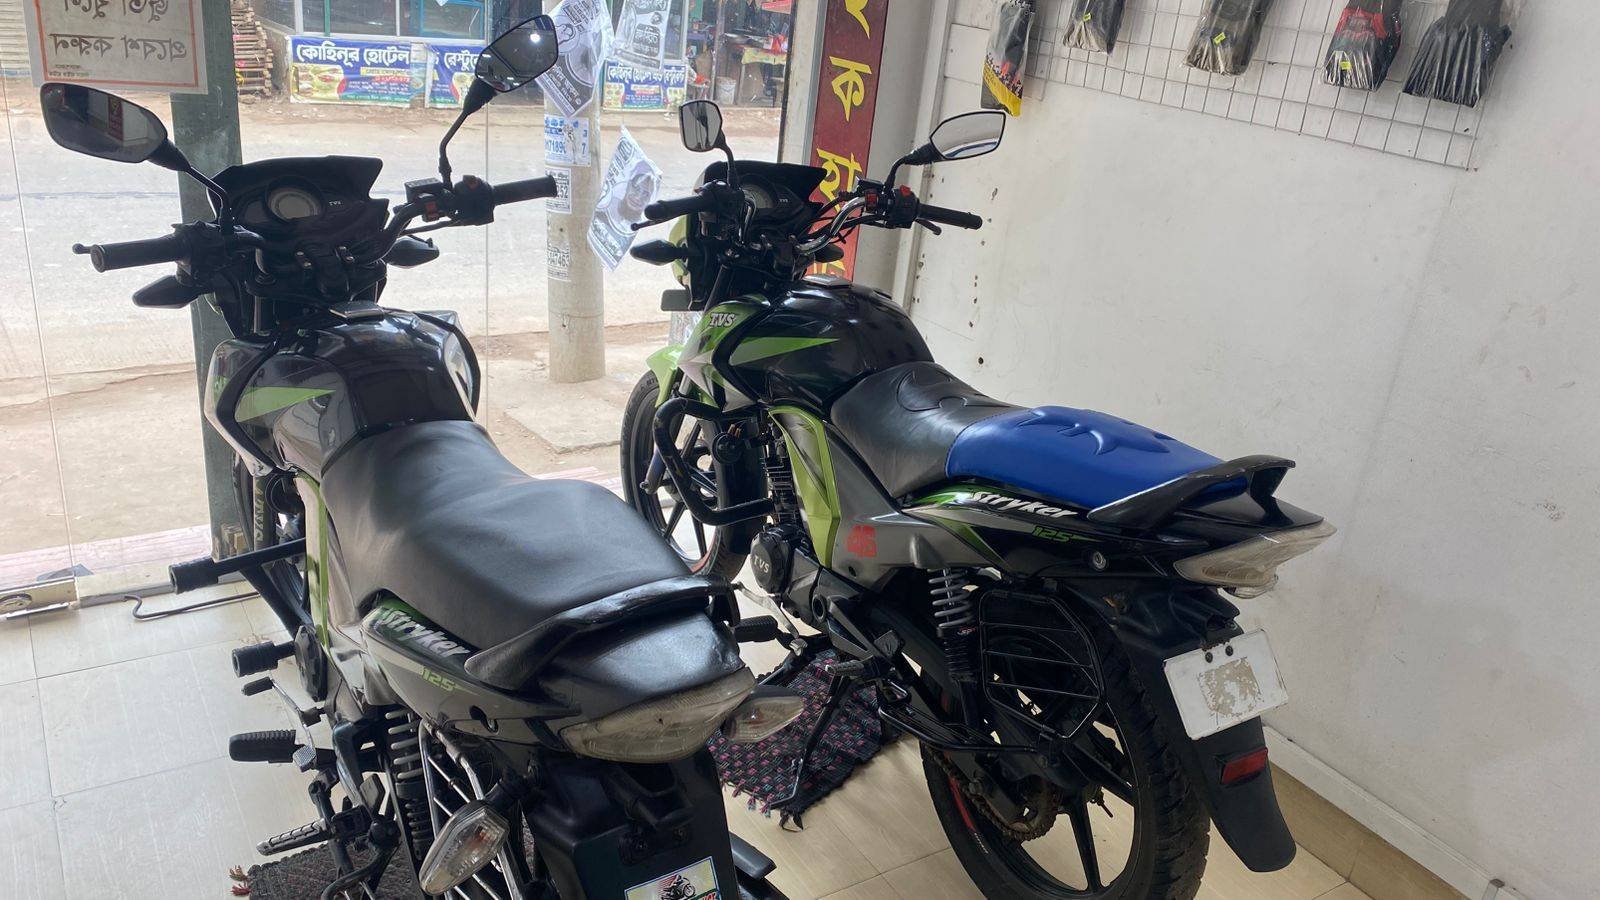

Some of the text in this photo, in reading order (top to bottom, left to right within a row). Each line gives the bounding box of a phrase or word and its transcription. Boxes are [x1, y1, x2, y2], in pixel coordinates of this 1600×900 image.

[296, 41, 360, 67] কোহিনূর
[363, 46, 410, 67] হোটেল
[709, 313, 736, 328] TVS
[971, 491, 1078, 518] Stryker
[1031, 525, 1074, 543] 125
[753, 554, 770, 573] TVS
[380, 608, 471, 658] Stryker
[421, 667, 456, 692] 125
